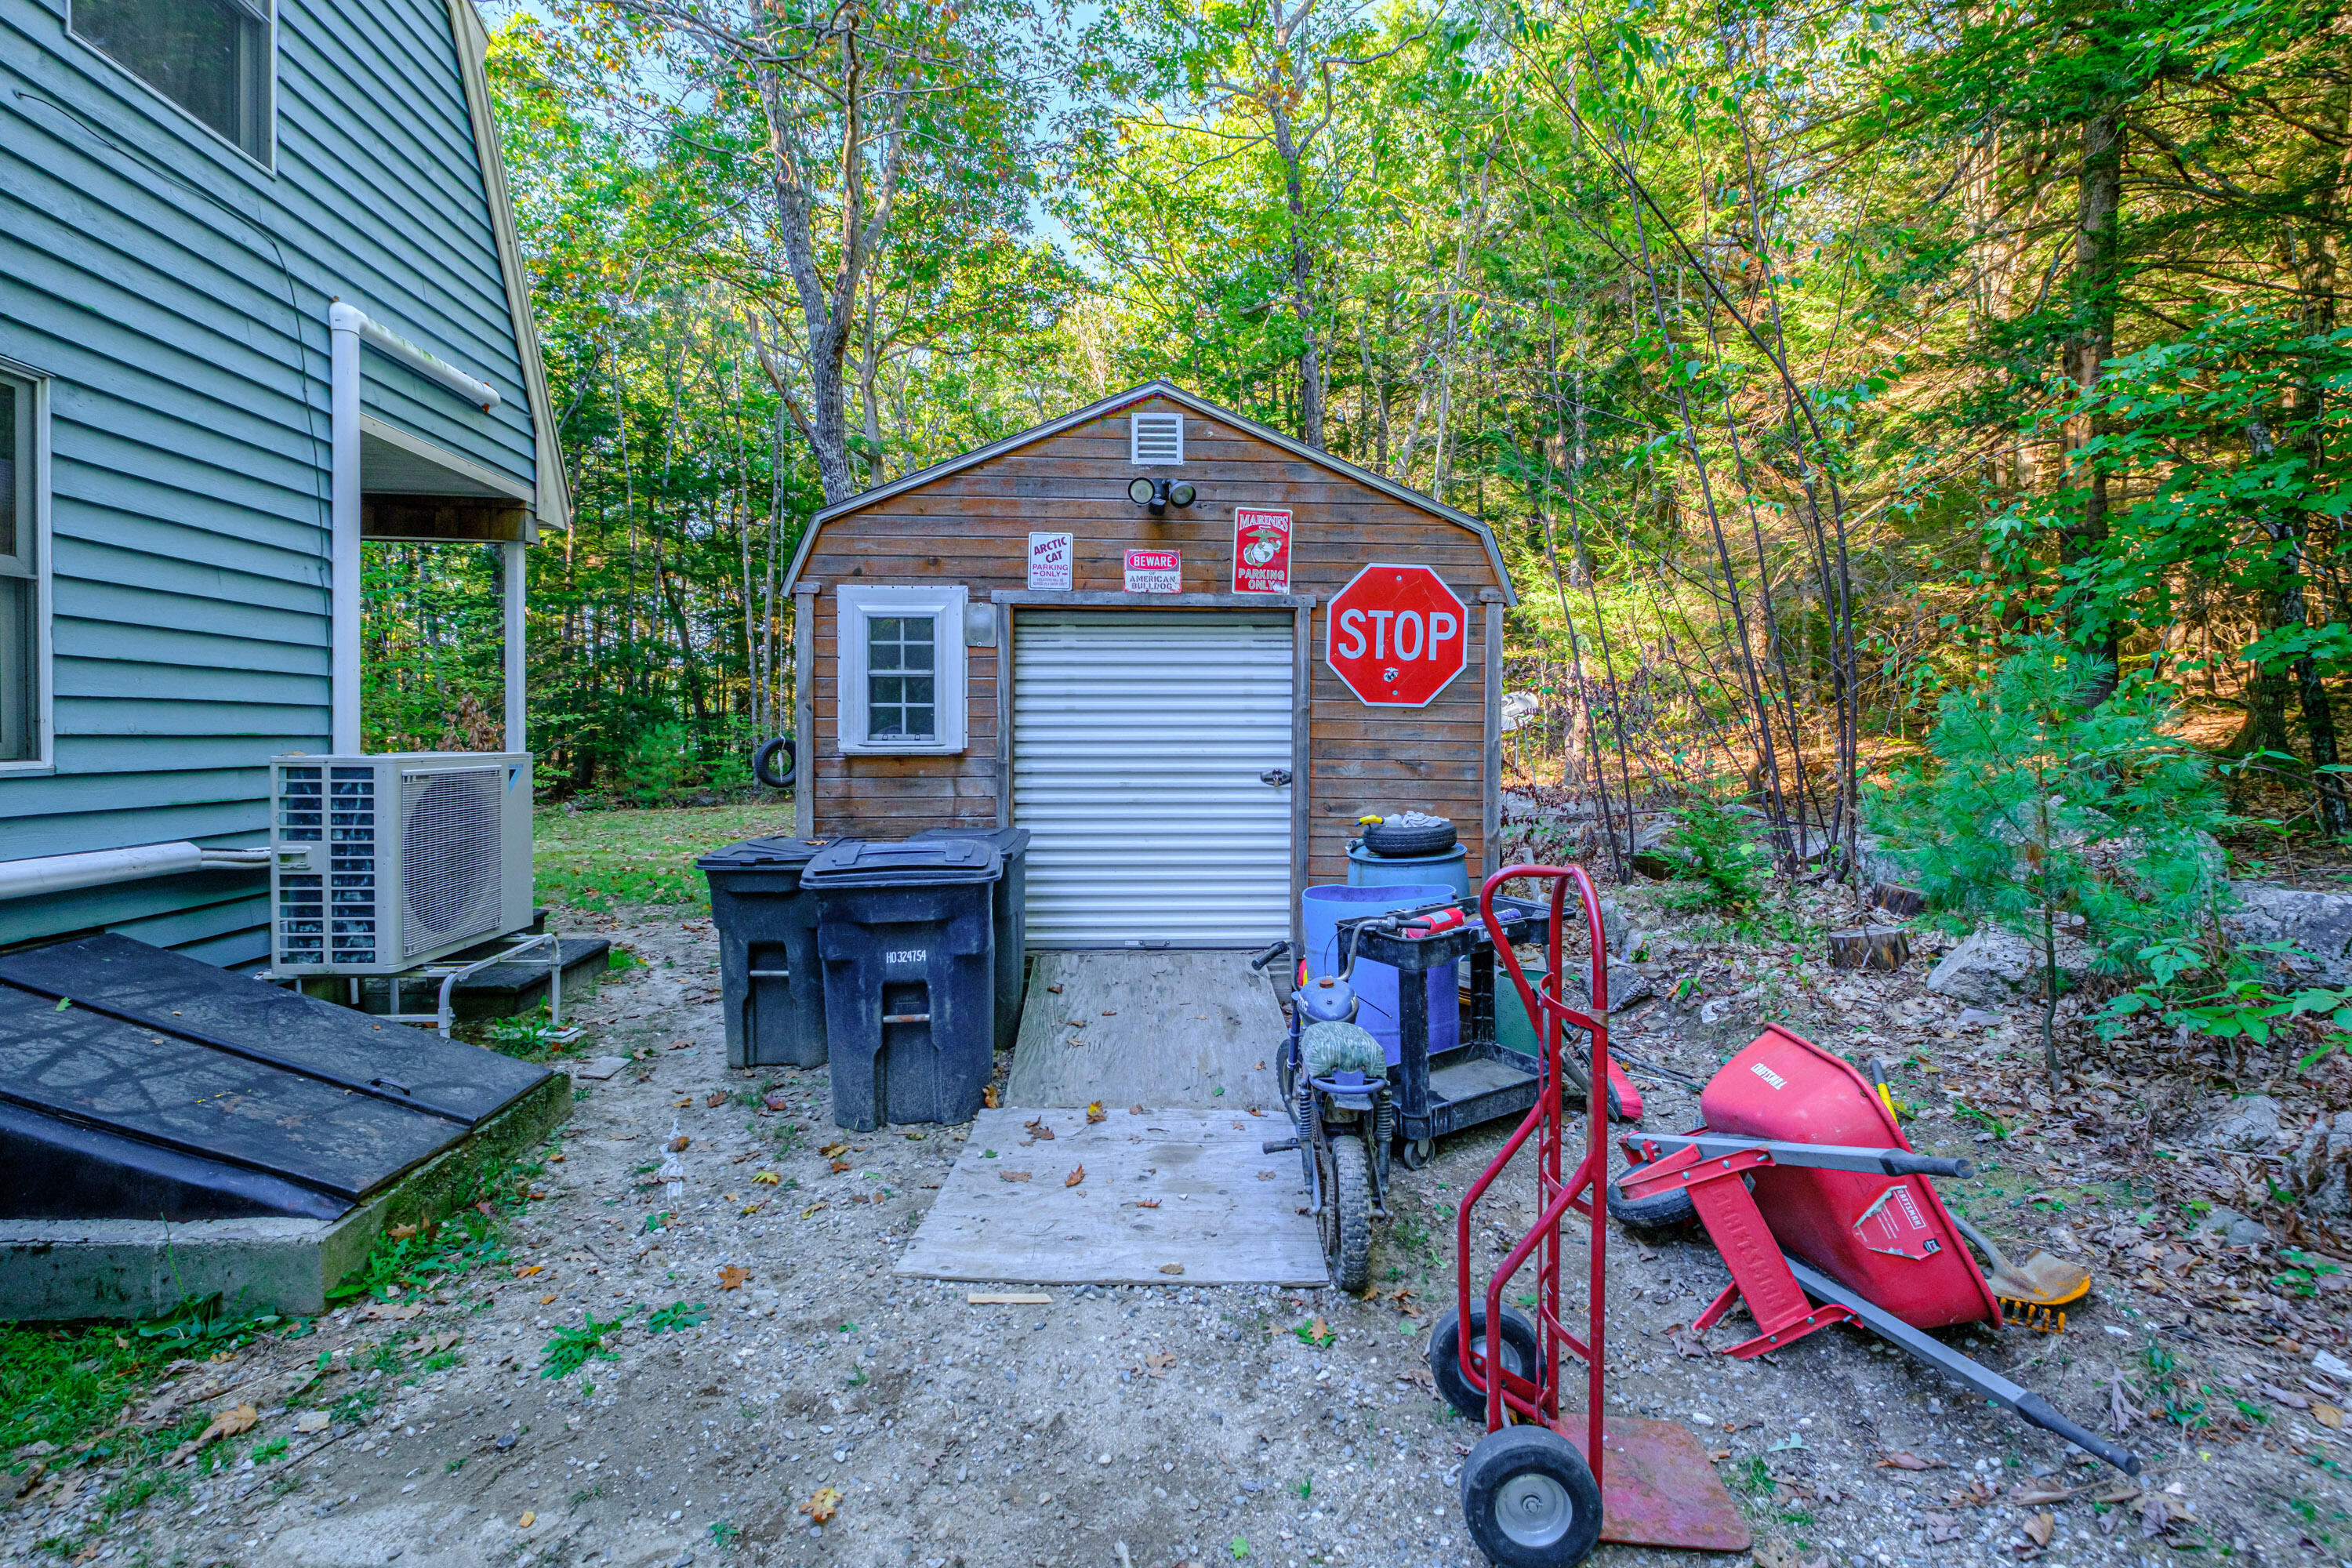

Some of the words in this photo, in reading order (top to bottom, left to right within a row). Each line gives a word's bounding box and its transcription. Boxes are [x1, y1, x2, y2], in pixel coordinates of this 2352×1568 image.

[1239, 514, 1288, 532] MARINES
[1034, 536, 1067, 556] ARCTIC
[1045, 550, 1062, 563] CAT
[1134, 556, 1172, 567] BEWARE
[1238, 568, 1284, 580] PARKING
[1248, 580, 1276, 590] ONLY
[1338, 608, 1457, 661] STOP
[1896, 1189, 1922, 1226] RAFTSMAN
